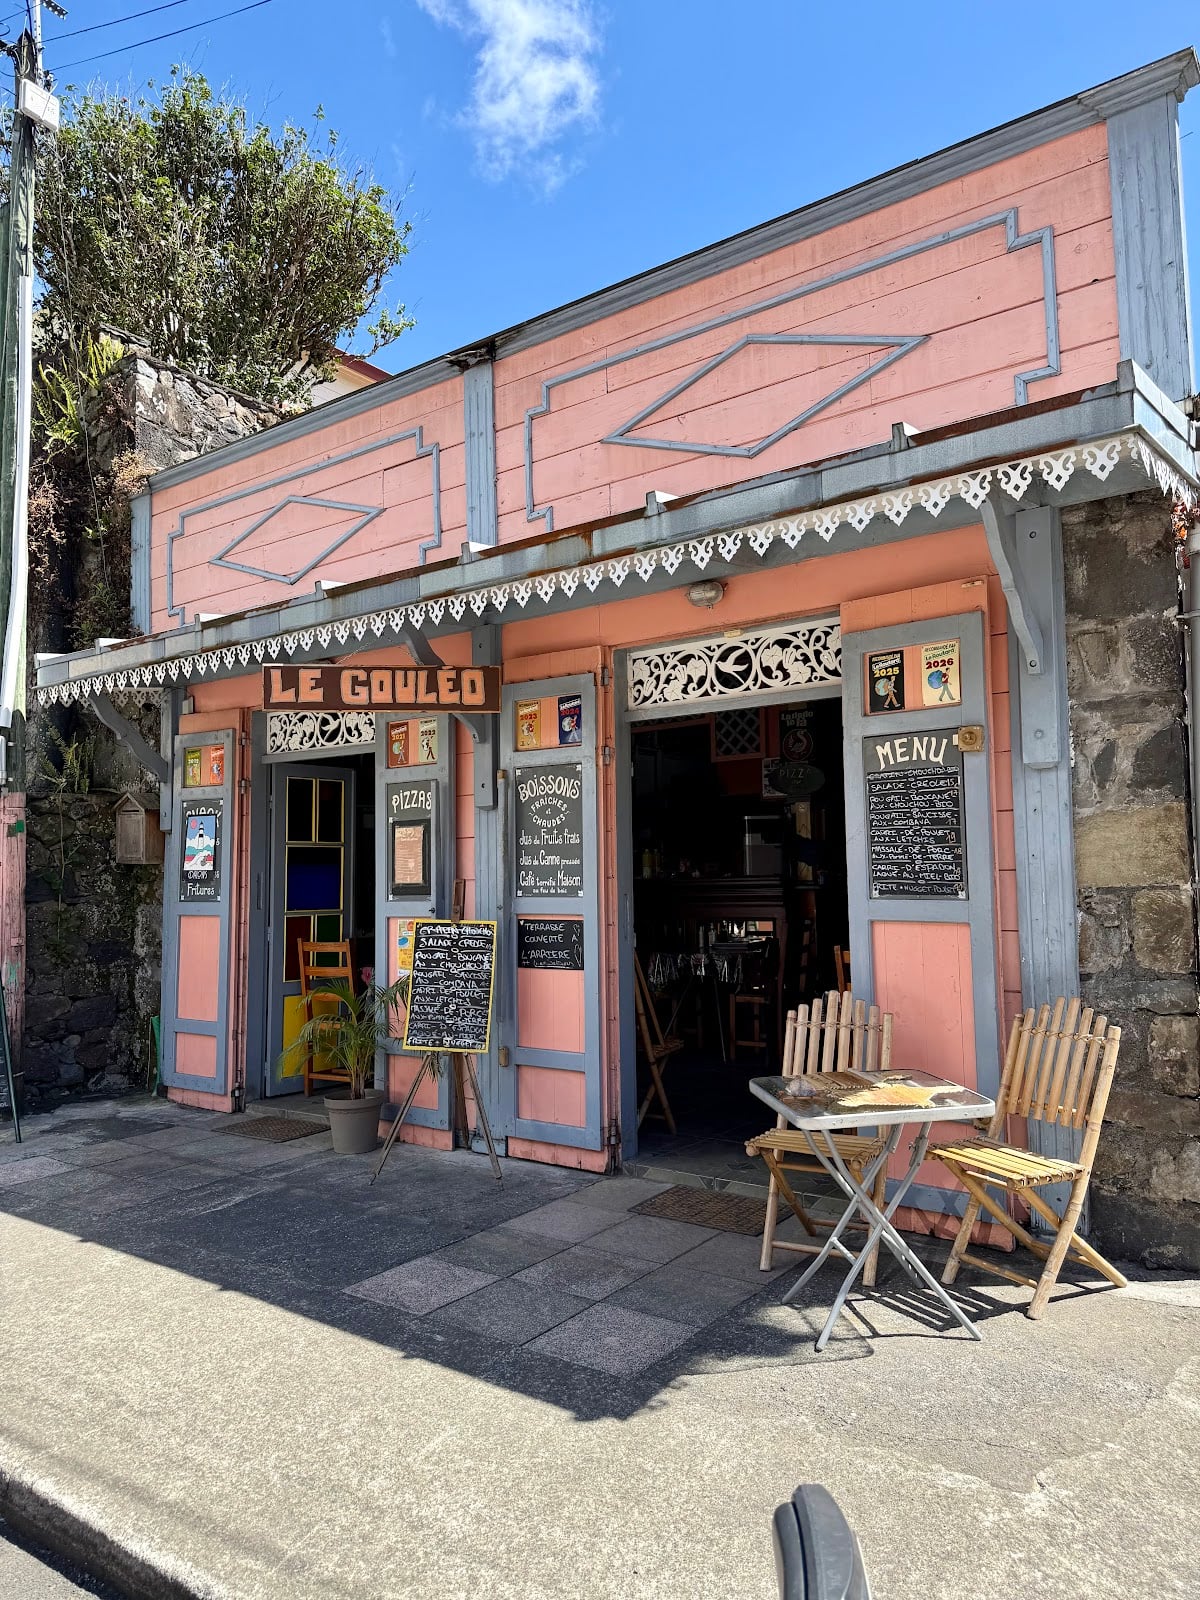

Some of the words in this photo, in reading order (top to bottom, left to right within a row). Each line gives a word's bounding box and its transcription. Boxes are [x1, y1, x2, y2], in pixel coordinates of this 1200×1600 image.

[926, 658, 954, 669] 2026
[874, 667, 900, 677] 2025
[269, 668, 324, 703] LE
[340, 665, 486, 706] GOULÉO
[875, 736, 948, 771] MENU
[532, 813, 566, 827] CHAUDES
[520, 829, 532, 846] Jus
[541, 828, 563, 846] Fruits
[564, 828, 580, 844] frais
[520, 850, 532, 866] Jus
[540, 849, 561, 866] Canne
[520, 870, 535, 886] Café
[558, 870, 581, 887] Maison
[187, 883, 215, 896] Fritures
[524, 923, 566, 931] TERRASSE
[524, 934, 564, 944] COUVERTE
